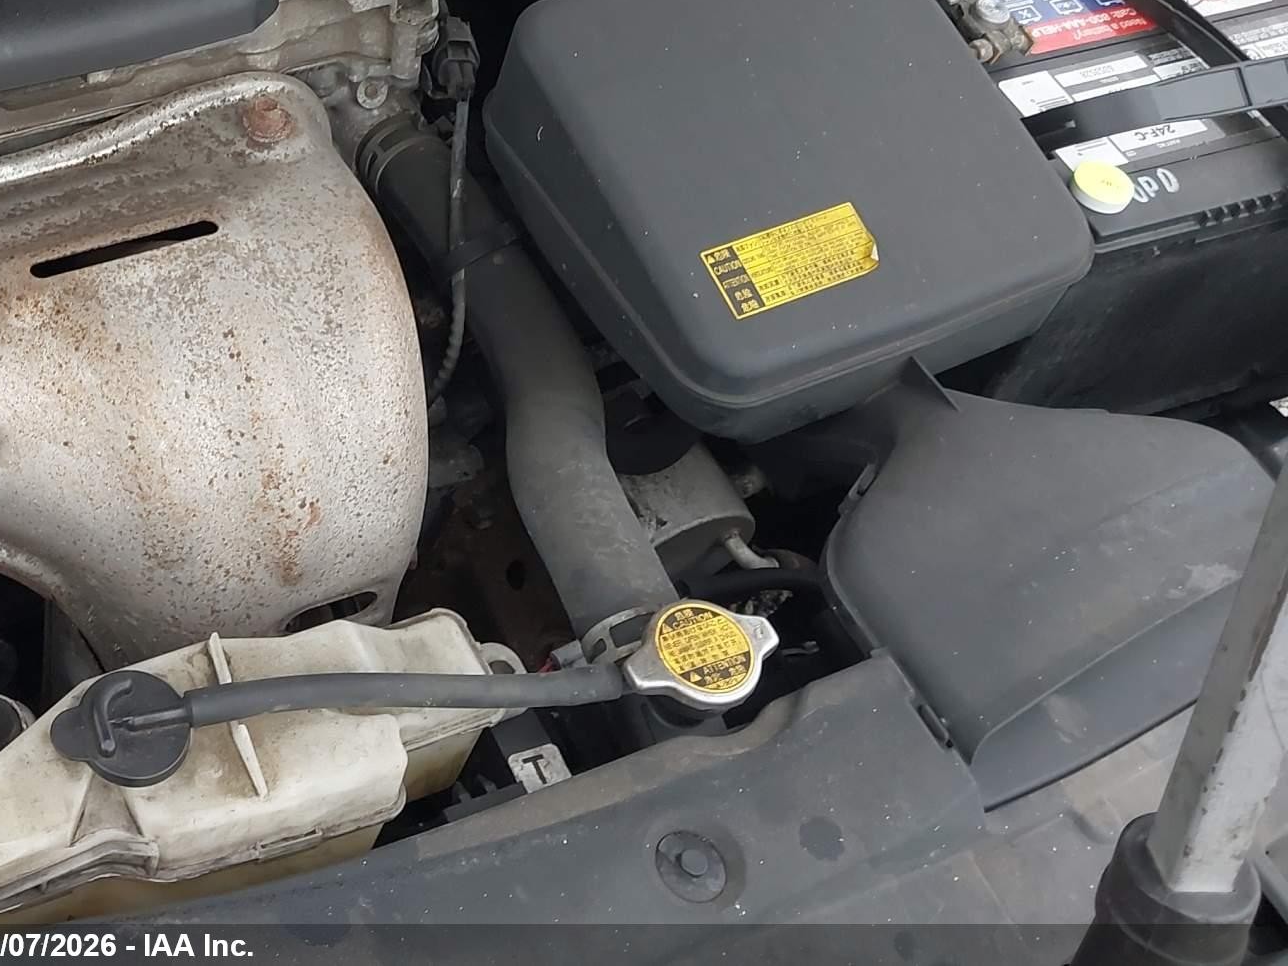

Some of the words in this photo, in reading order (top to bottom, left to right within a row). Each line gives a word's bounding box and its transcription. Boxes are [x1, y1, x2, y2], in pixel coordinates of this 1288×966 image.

[1134, 124, 1176, 141] 24F-C
[714, 260, 742, 275] CAUTION
[672, 612, 713, 629] CAUTION
[703, 656, 746, 674] ATTENTION
[521, 754, 545, 785] T
